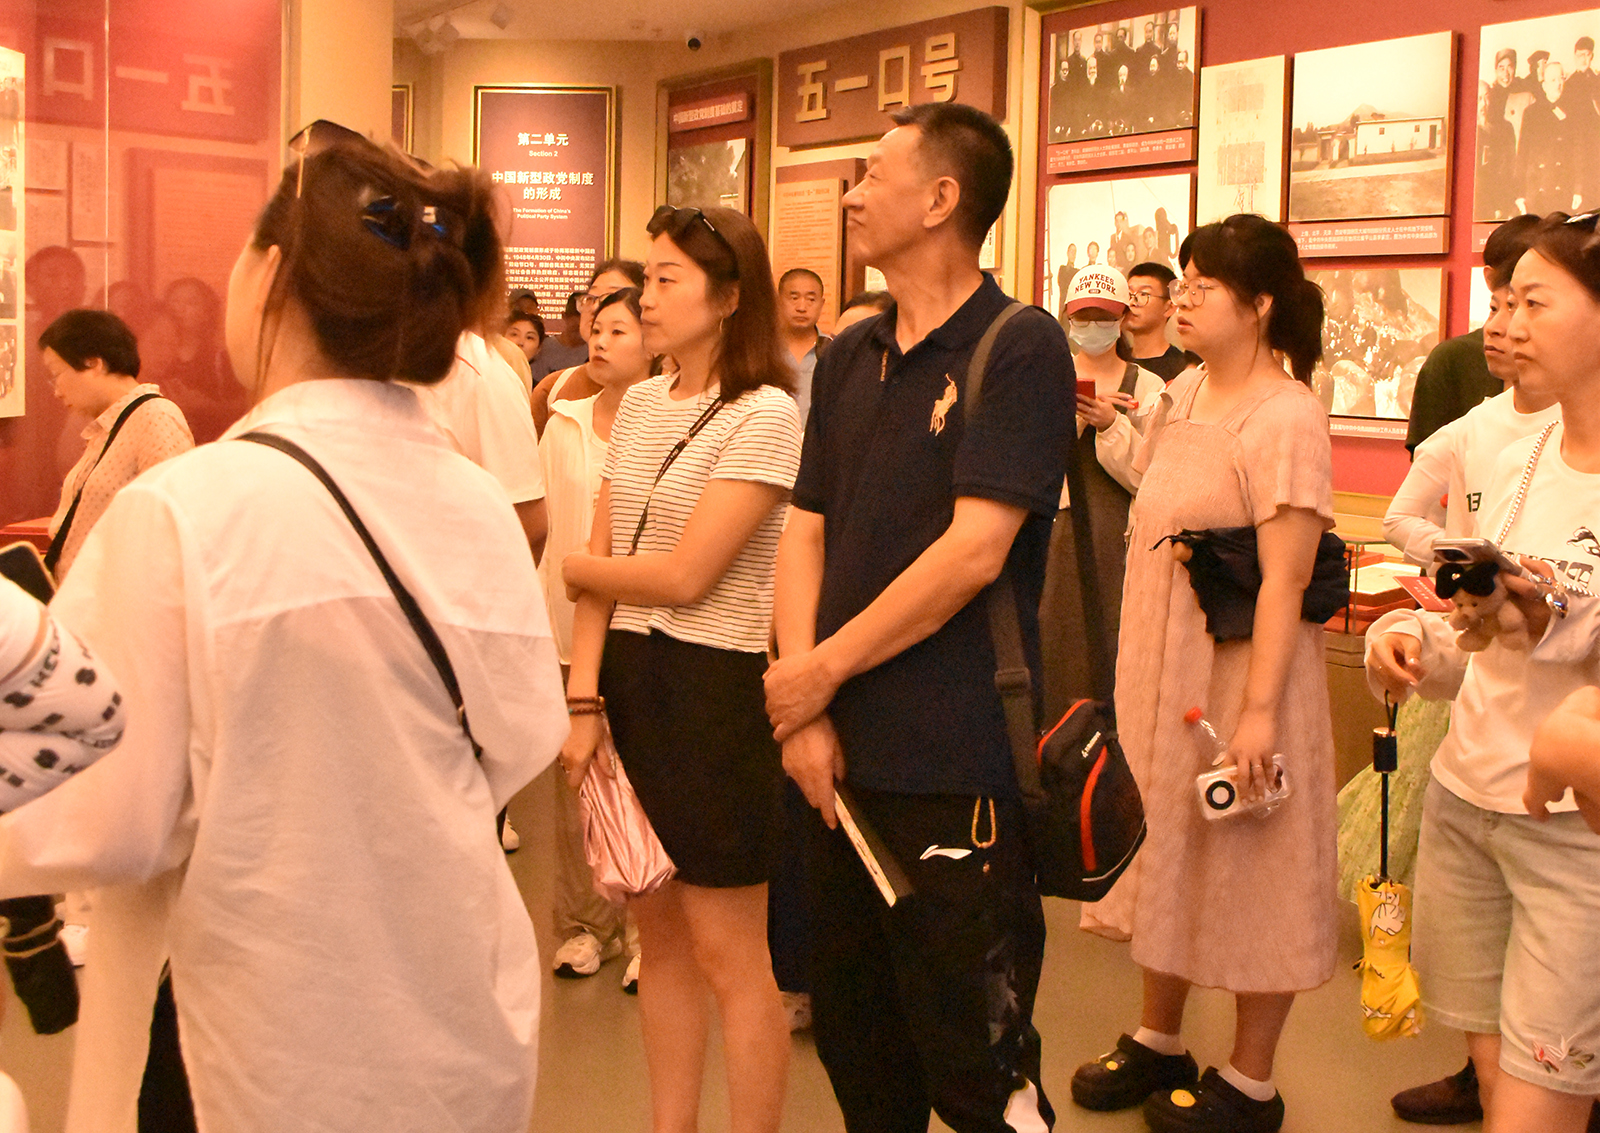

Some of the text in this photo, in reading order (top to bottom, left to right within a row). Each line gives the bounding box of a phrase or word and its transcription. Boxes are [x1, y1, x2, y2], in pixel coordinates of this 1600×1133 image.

[795, 32, 960, 123] 五一口号
[517, 132, 569, 146] 第二单元
[492, 170, 594, 185] 中国新型政党制度
[523, 187, 562, 200] 的形成
[1079, 274, 1114, 286] YANKEES
[1074, 281, 1116, 295] NEW YORK
[1466, 492, 1482, 512] 13
